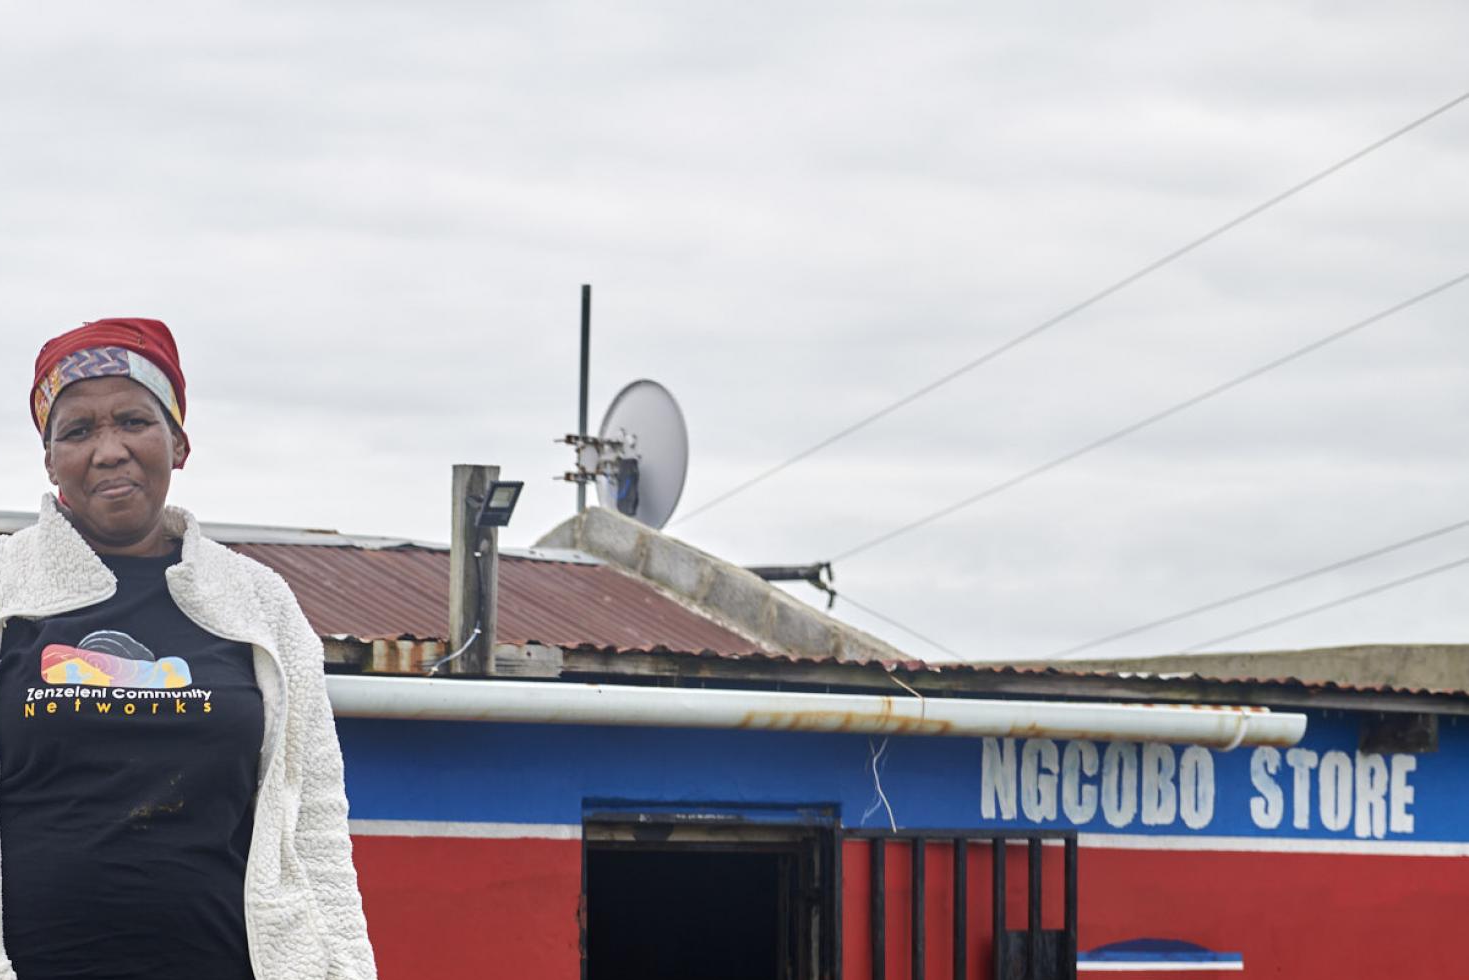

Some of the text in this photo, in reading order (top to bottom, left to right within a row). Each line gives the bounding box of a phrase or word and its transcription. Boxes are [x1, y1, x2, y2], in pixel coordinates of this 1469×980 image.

[26, 686, 213, 702] Zenzeleni Community
[23, 698, 213, 718] Networks
[980, 736, 1418, 840] NGCOBO STORE
